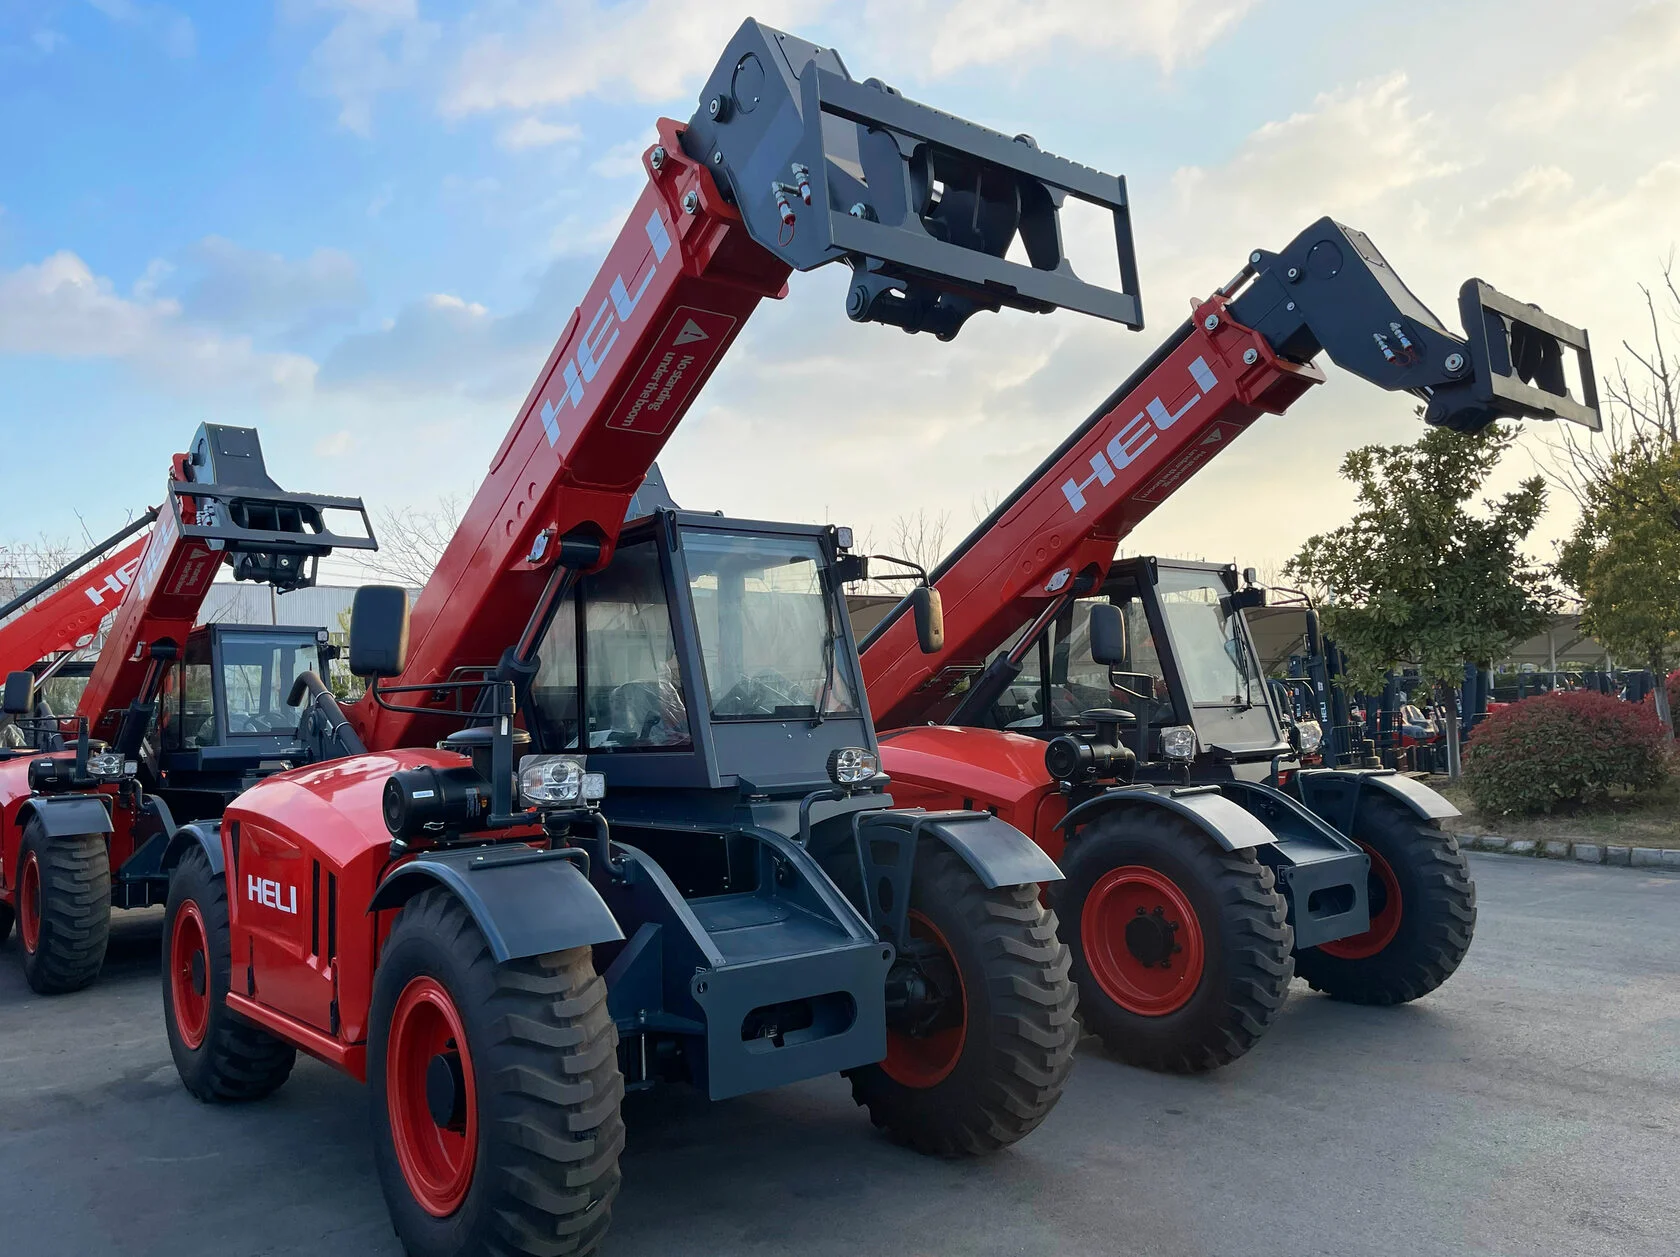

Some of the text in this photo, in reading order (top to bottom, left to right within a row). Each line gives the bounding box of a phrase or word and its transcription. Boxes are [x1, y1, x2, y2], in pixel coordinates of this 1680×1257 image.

[540, 208, 671, 448] HELI
[622, 352, 676, 427] under the boom
[648, 355, 695, 411] No standing
[1061, 356, 1219, 513] HELI
[84, 557, 139, 606] HE
[138, 519, 175, 600] HEL
[1319, 701, 1328, 722] HELI
[247, 874, 298, 915] HELI
